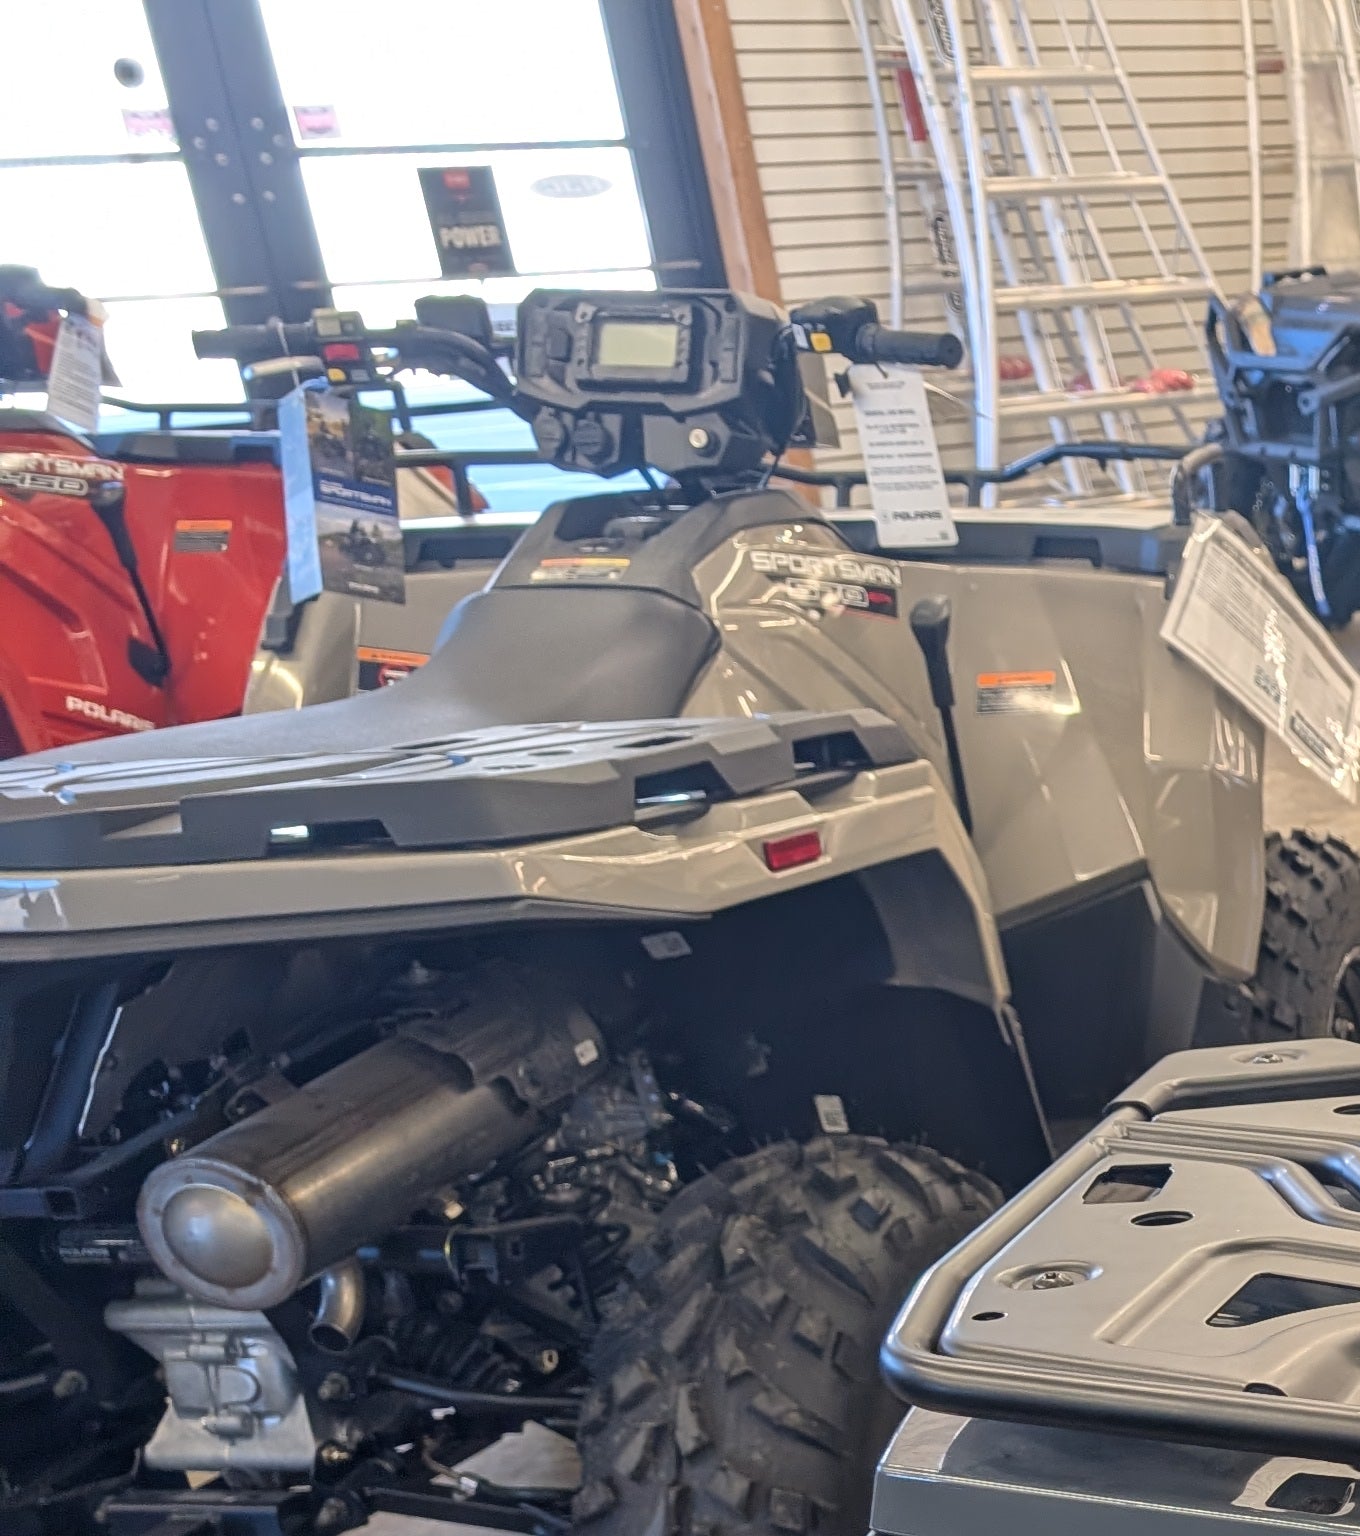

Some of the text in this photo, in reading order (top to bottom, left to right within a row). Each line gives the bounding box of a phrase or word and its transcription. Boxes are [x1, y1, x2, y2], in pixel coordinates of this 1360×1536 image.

[439, 225, 500, 249] POWER
[892, 510, 943, 521] POLARIS
[751, 551, 903, 586] SPORTSMAN
[65, 695, 155, 730] POLARIS
